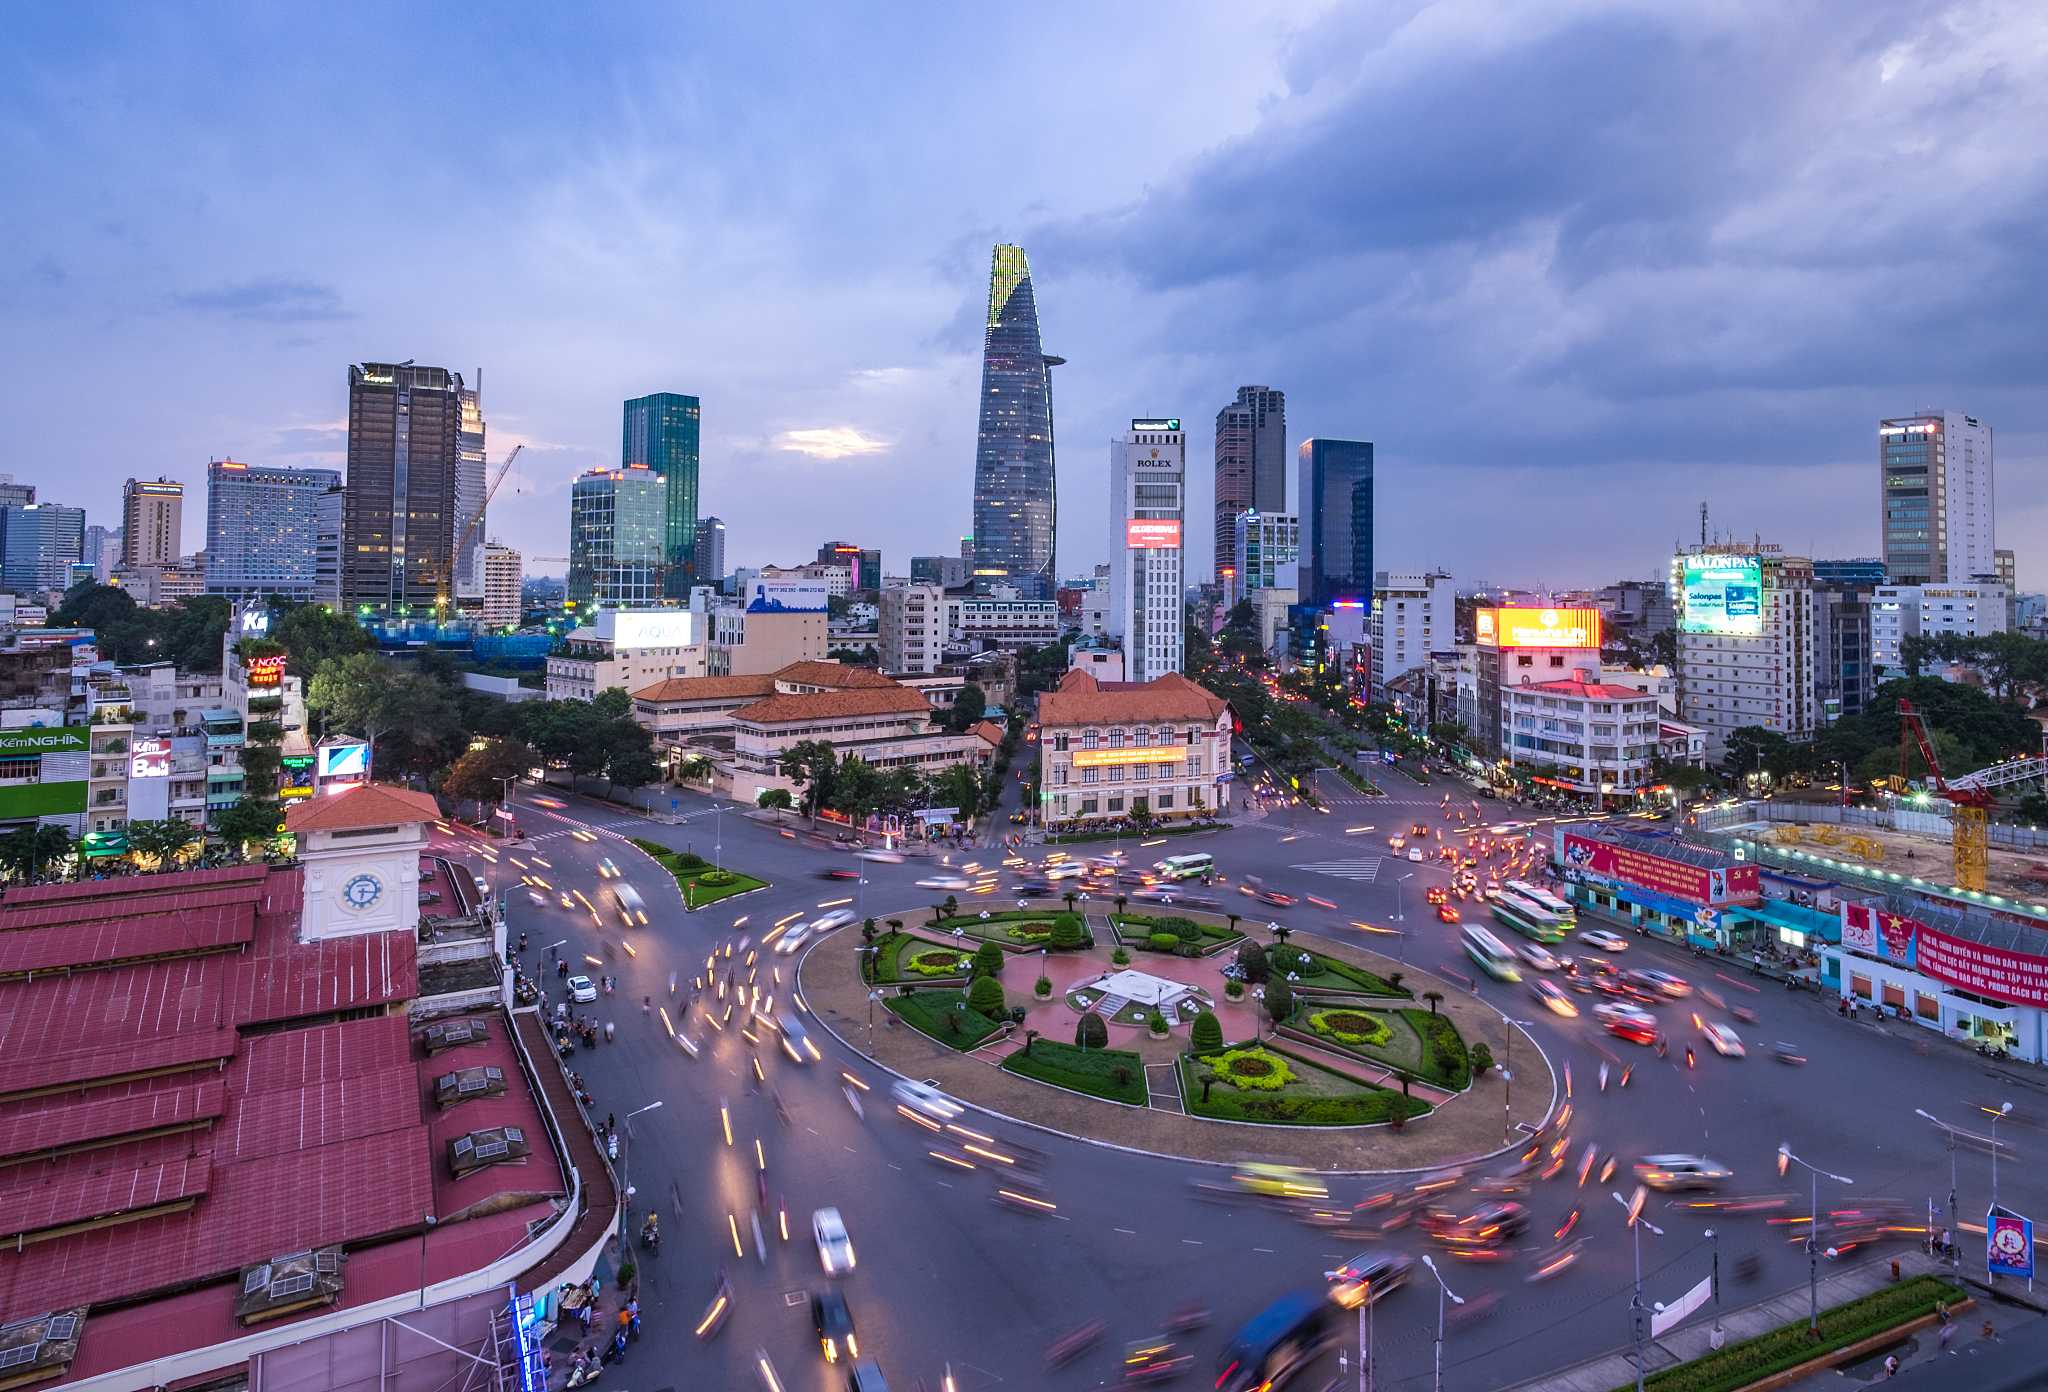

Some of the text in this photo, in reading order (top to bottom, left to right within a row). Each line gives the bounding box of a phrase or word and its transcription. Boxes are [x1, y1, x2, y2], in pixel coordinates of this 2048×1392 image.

[1689, 593, 1722, 601] Salonpas
[1512, 627, 1586, 638] Hanwha Life
[1953, 945, 1971, 958] QUYỀN
[1973, 950, 1981, 961] VÀ
[1983, 954, 2000, 966] NHÂN
[2003, 958, 2017, 969] DÂN
[2019, 961, 2042, 974] THÀNH
[1972, 964, 1990, 976] MẠNH
[1992, 968, 2005, 981] HỌC
[2007, 972, 2021, 984] TẬP
[2023, 975, 2033, 985] VÀ
[1959, 972, 1970, 983] ĐẠO
[1988, 981, 2009, 994] PHONG
[2011, 986, 2030, 998] CÁCH
[2032, 988, 2041, 1000] HỒ
